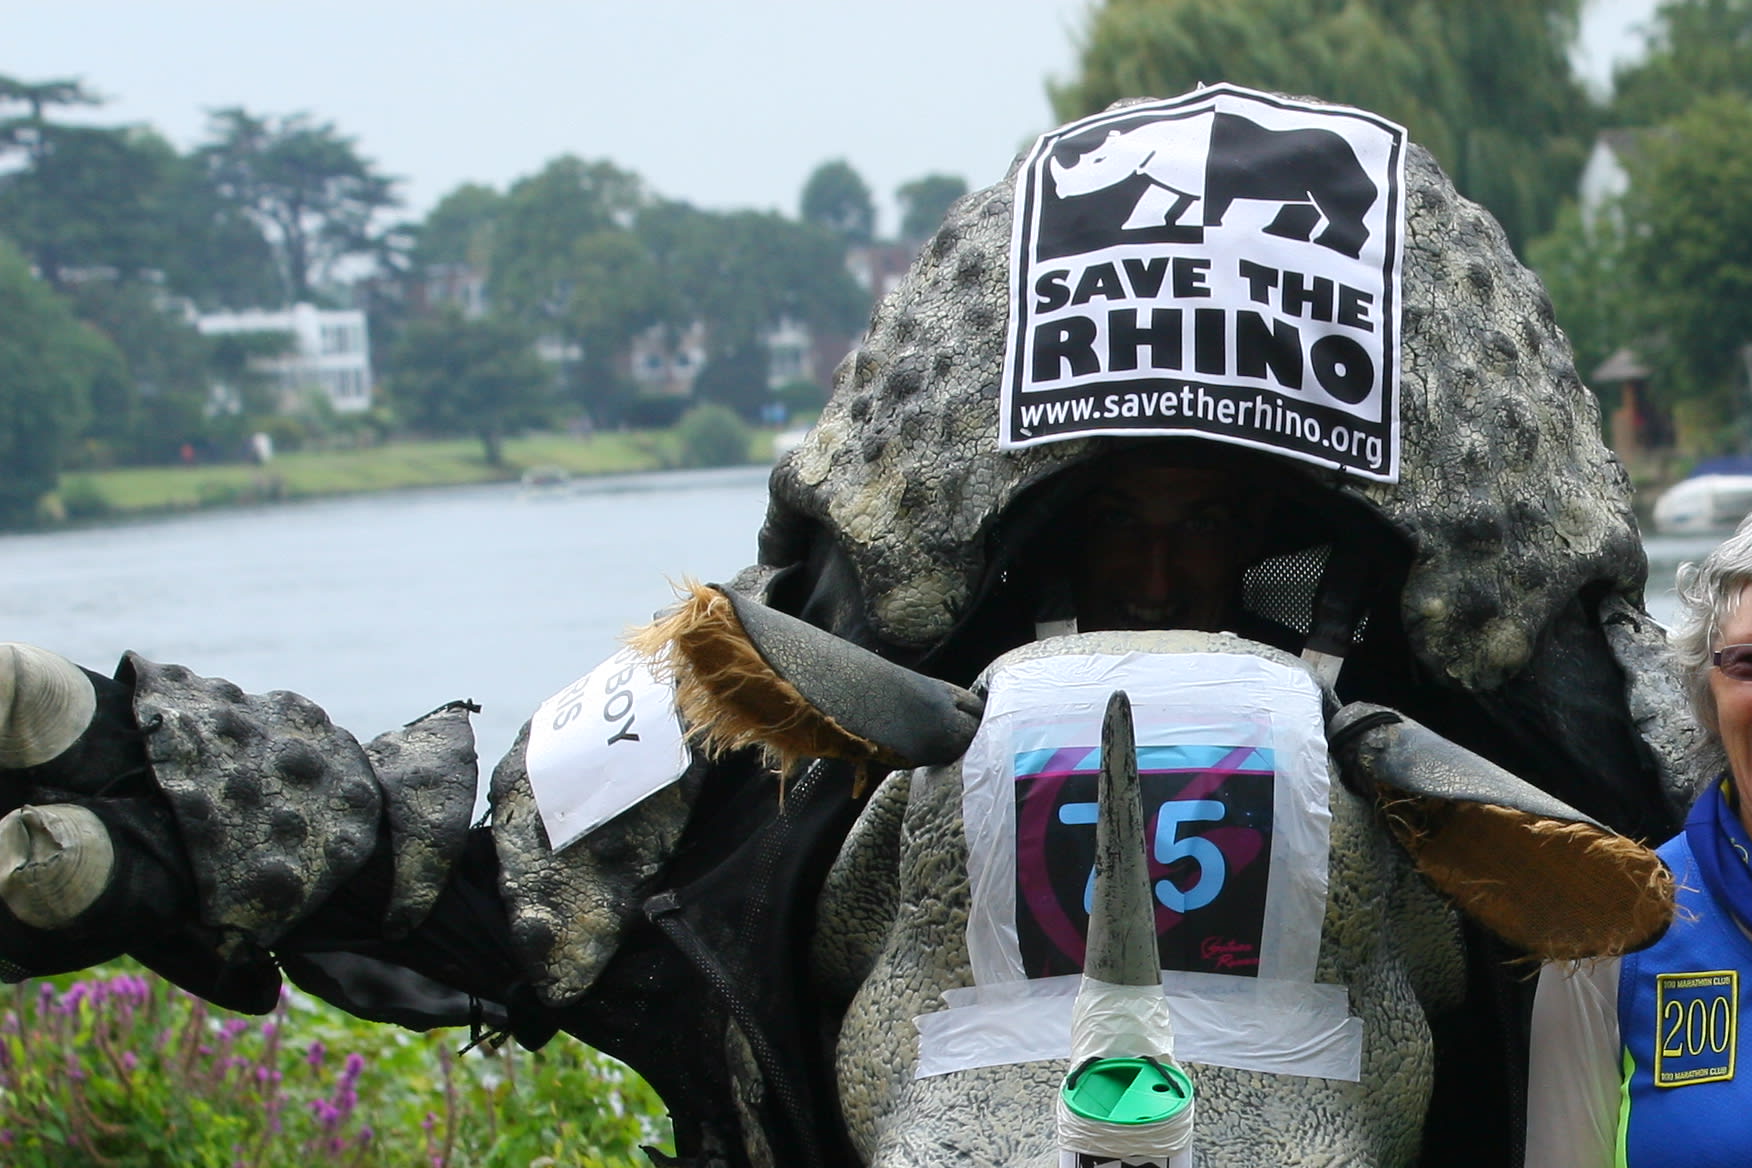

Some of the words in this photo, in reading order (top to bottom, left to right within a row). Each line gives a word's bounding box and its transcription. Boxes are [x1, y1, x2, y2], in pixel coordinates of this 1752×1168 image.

[1034, 256, 1212, 314] SAVE
[1239, 258, 1374, 333] THE
[1031, 307, 1374, 405] RHINO
[1020, 385, 1382, 469] www.savetherhino.org
[1662, 996, 1731, 1058] 200
